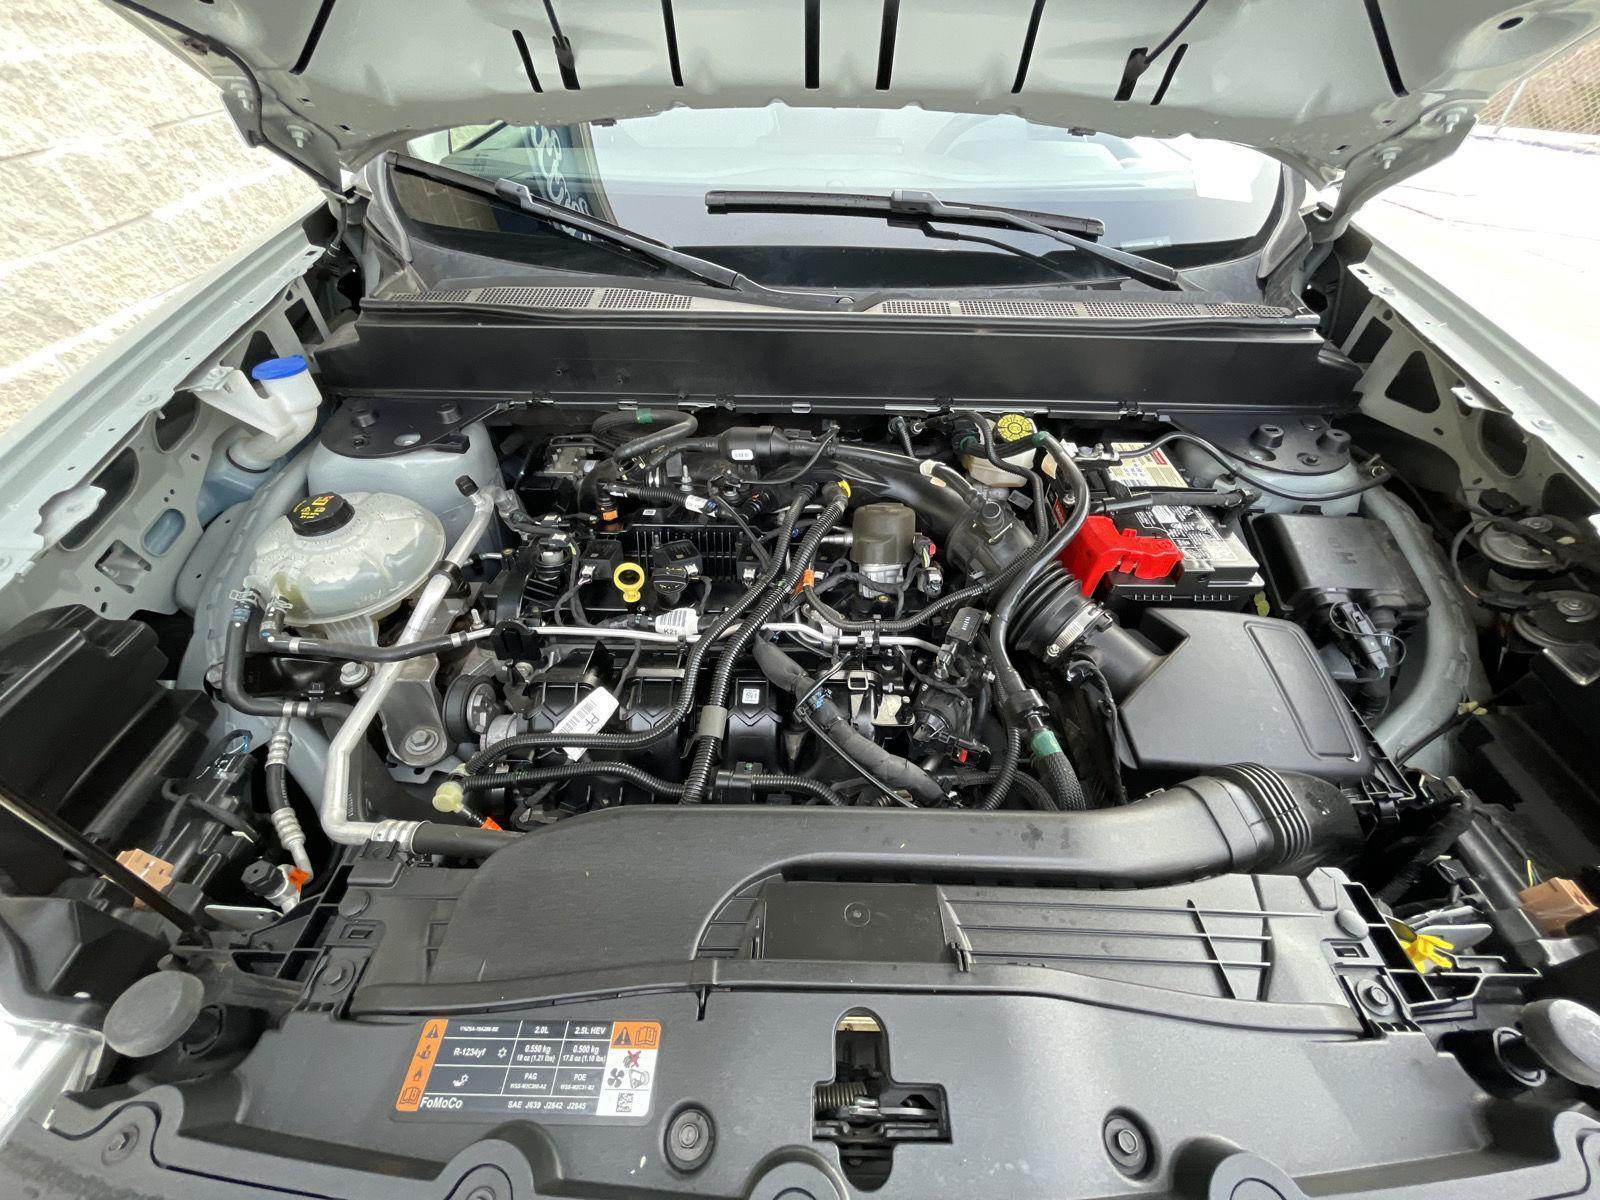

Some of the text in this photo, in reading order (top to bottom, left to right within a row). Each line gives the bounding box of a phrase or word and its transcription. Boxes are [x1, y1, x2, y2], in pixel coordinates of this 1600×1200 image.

[585, 713, 600, 732] PF
[534, 1026, 549, 1034] 2.0L
[574, 1027, 606, 1035] 2.5L HEV
[453, 1048, 487, 1058] R-1234yf
[525, 1045, 551, 1054] 0.550 kg
[573, 1045, 600, 1055] 0.500 kg
[574, 1073, 587, 1081] POE
[420, 1097, 463, 1109] FoMoCo
